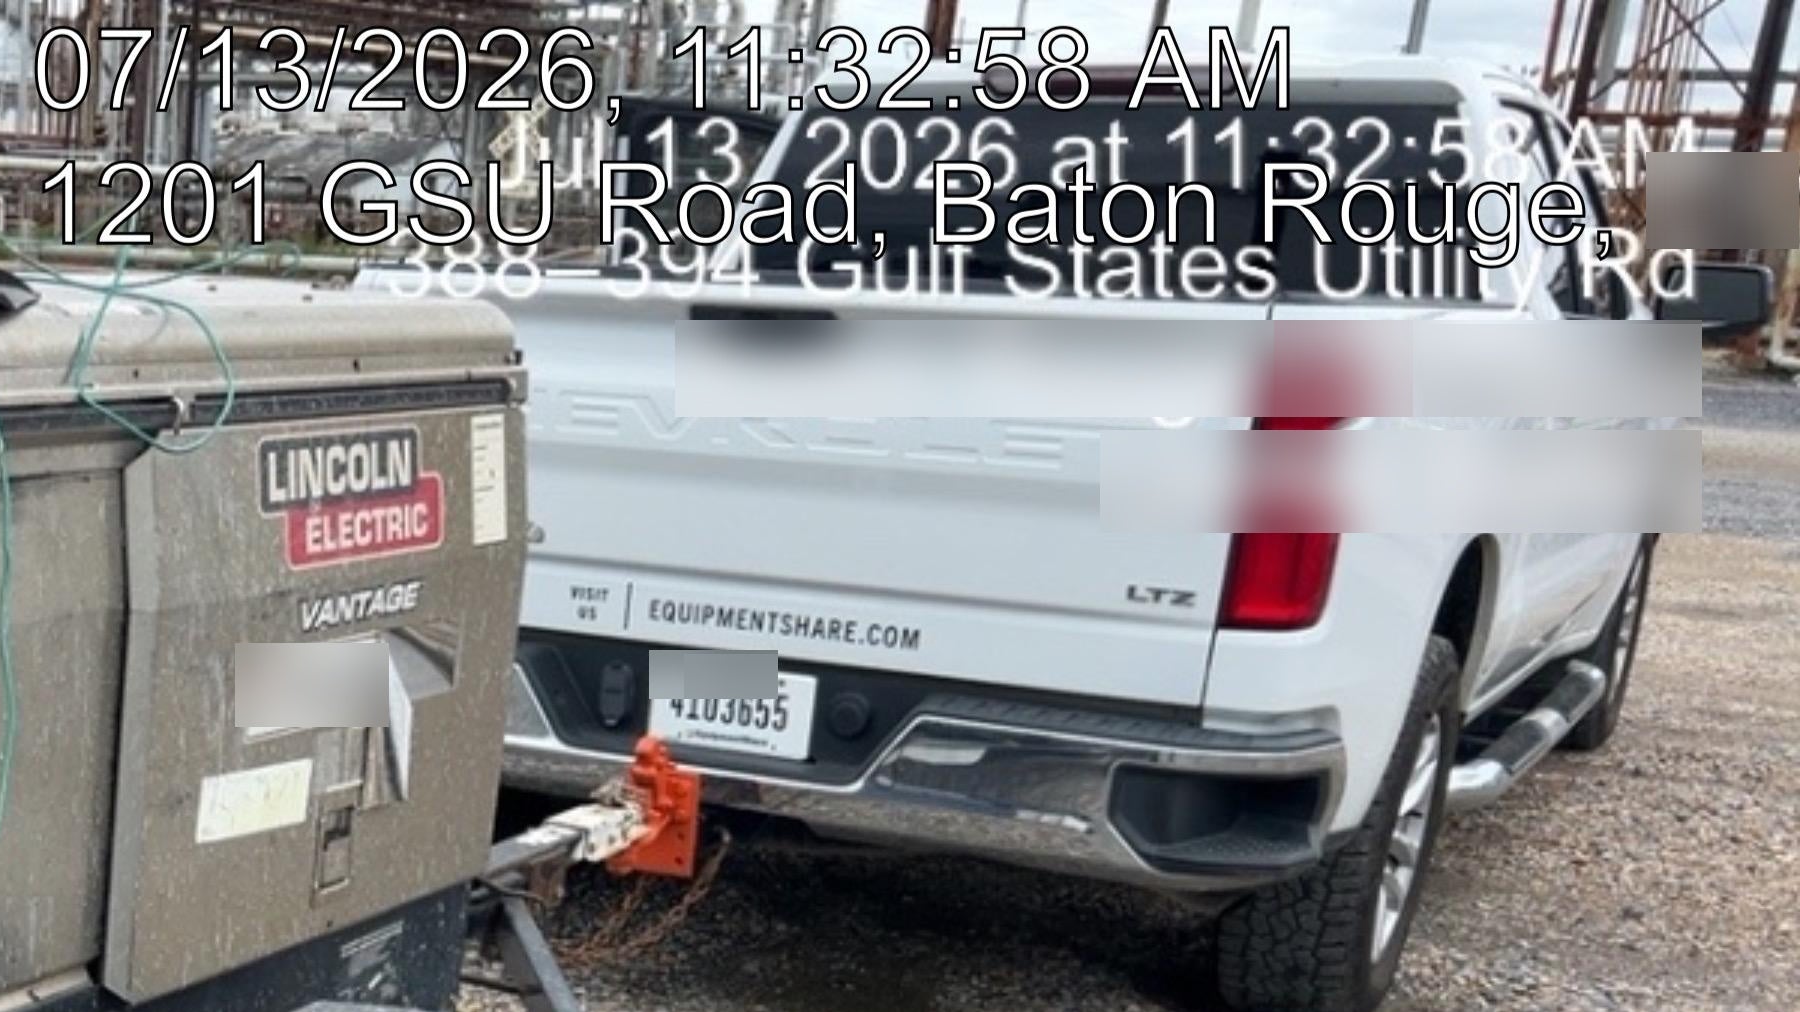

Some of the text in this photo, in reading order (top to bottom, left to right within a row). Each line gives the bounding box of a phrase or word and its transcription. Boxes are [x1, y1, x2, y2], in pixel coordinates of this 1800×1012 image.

[265, 437, 413, 504] LINCOLN
[304, 503, 431, 555] ELECTRIC
[299, 581, 424, 632] VANTAGE
[570, 585, 610, 603] VISIT
[577, 606, 598, 622] US
[1125, 583, 1197, 608] LTZ
[647, 598, 922, 651] EQUIPMENTSHARE.COM
